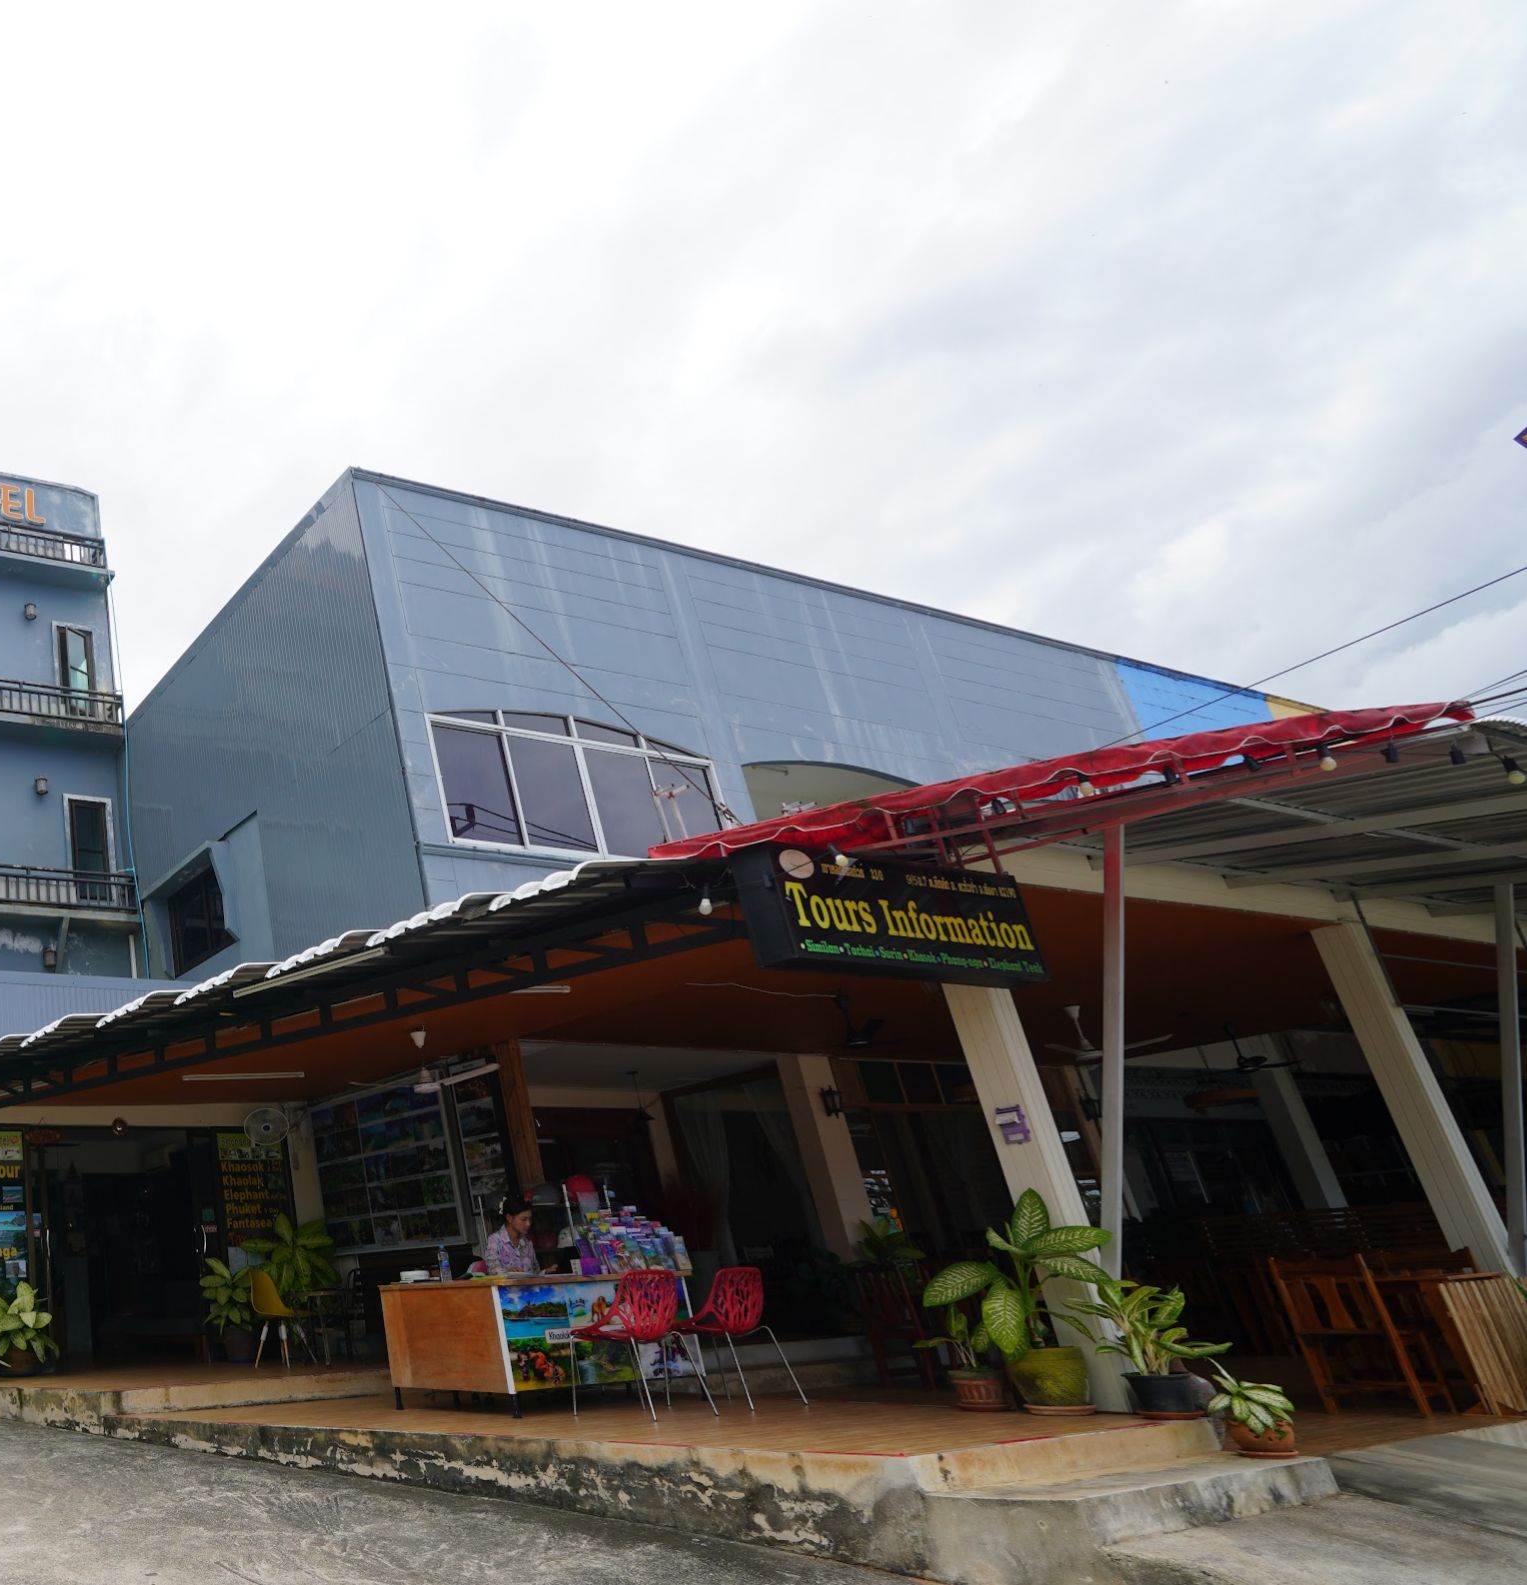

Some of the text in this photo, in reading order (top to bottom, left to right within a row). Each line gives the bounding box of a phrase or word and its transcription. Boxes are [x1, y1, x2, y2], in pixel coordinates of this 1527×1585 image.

[785, 881, 1035, 951] Tours Information
[221, 1161, 265, 1173] Khaosok
[224, 1189, 270, 1202] Elephant
[226, 1203, 262, 1216] Phuket
